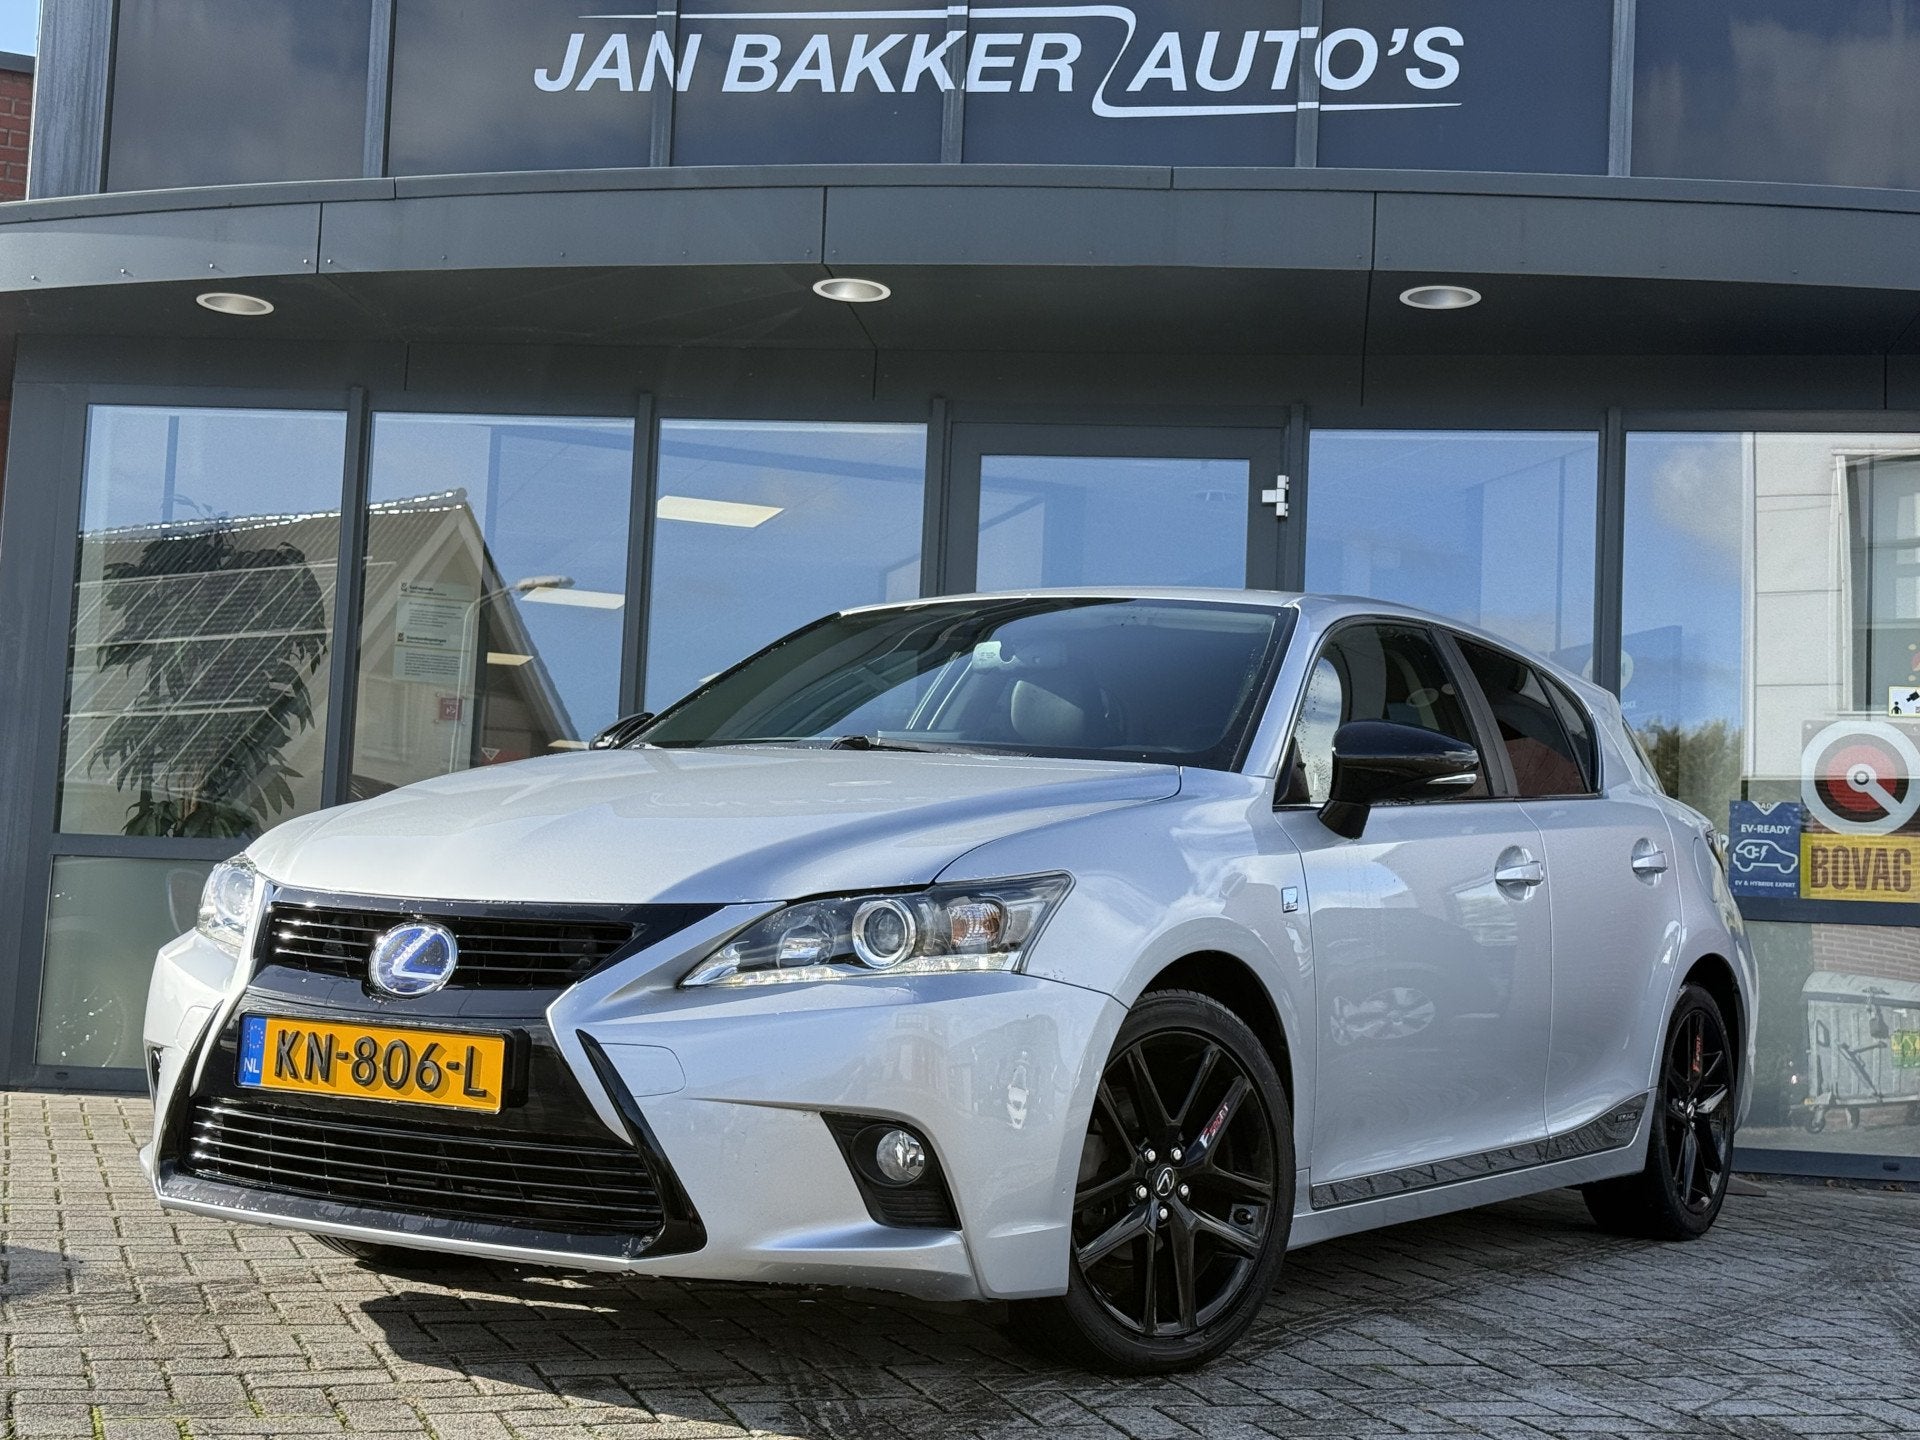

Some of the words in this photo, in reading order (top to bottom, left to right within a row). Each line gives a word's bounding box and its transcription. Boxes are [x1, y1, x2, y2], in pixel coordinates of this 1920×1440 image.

[534, 31, 702, 92] JAN
[722, 30, 1082, 93] BAKKER
[1126, 26, 1464, 92] AUTO'S
[1740, 824, 1791, 834] EV-READY
[1810, 846, 1912, 892] BOVAG
[243, 1057, 260, 1074] NL
[274, 1029, 487, 1098] KN-806-L
